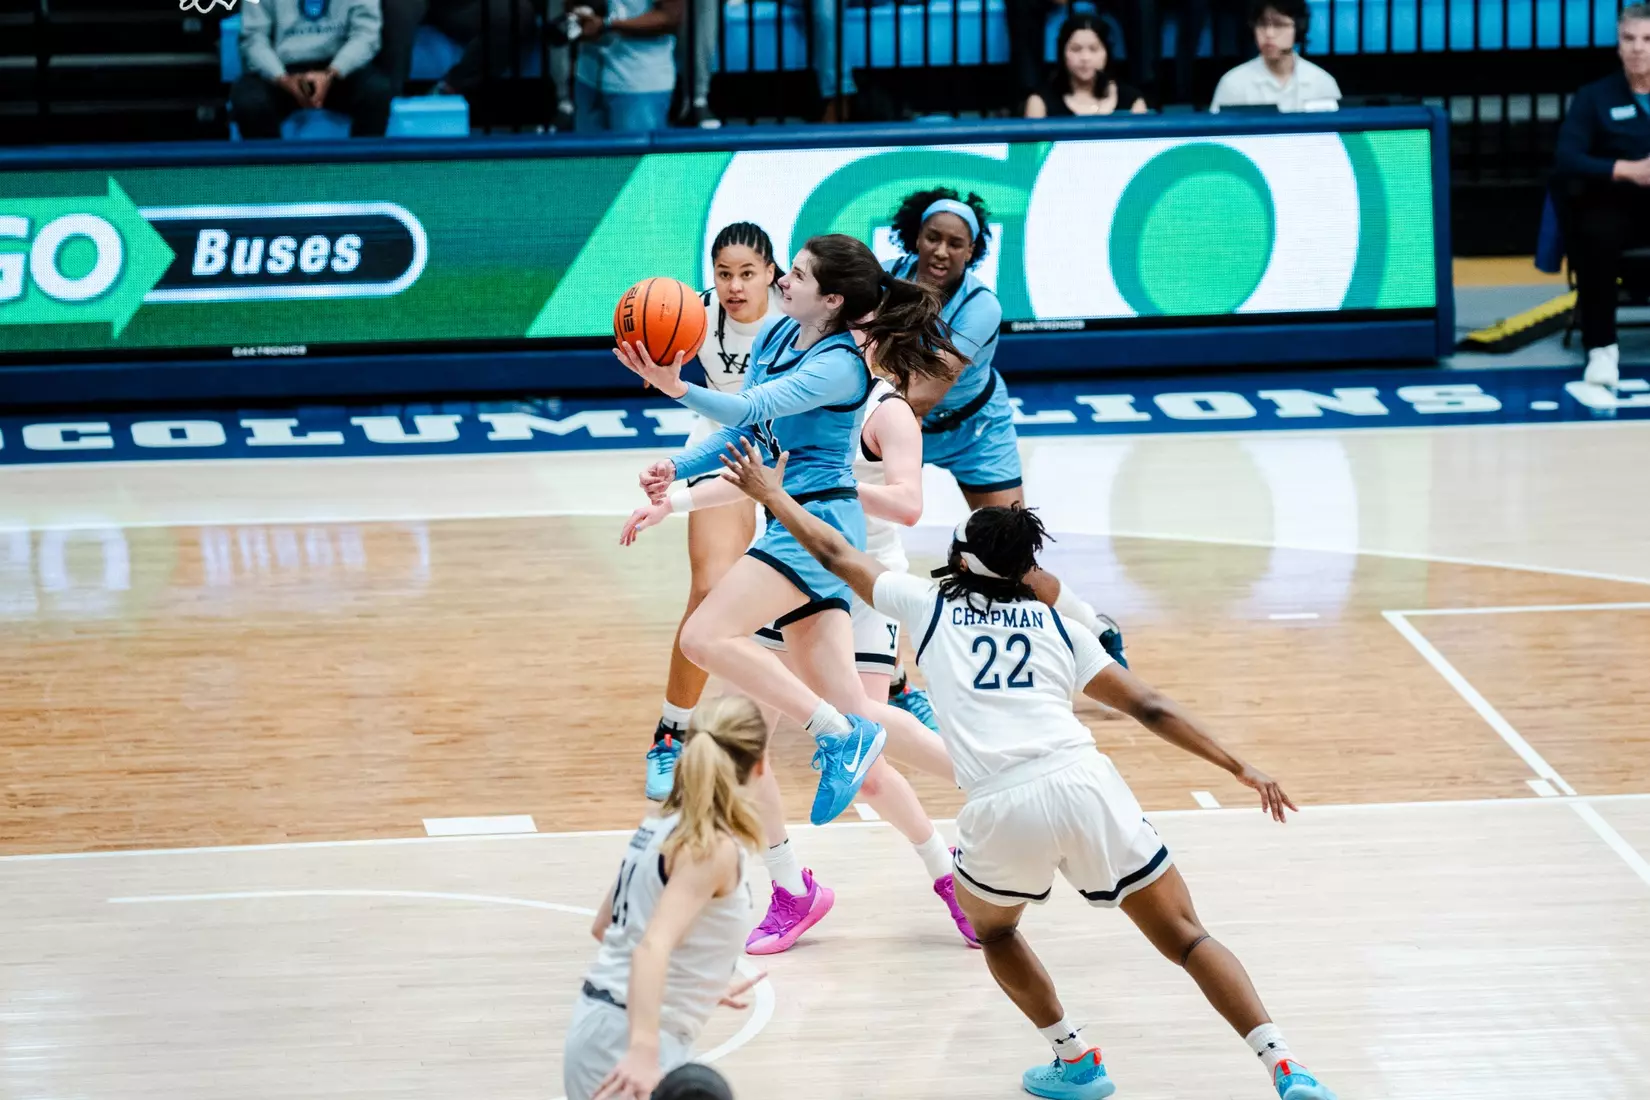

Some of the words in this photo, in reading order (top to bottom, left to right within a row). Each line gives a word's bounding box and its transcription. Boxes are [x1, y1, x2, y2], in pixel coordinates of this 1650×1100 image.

[192, 229, 363, 276] Buses
[0, 408, 701, 450] COLUM
[952, 606, 1044, 629] CHAPMAN
[971, 633, 1034, 690] 22
